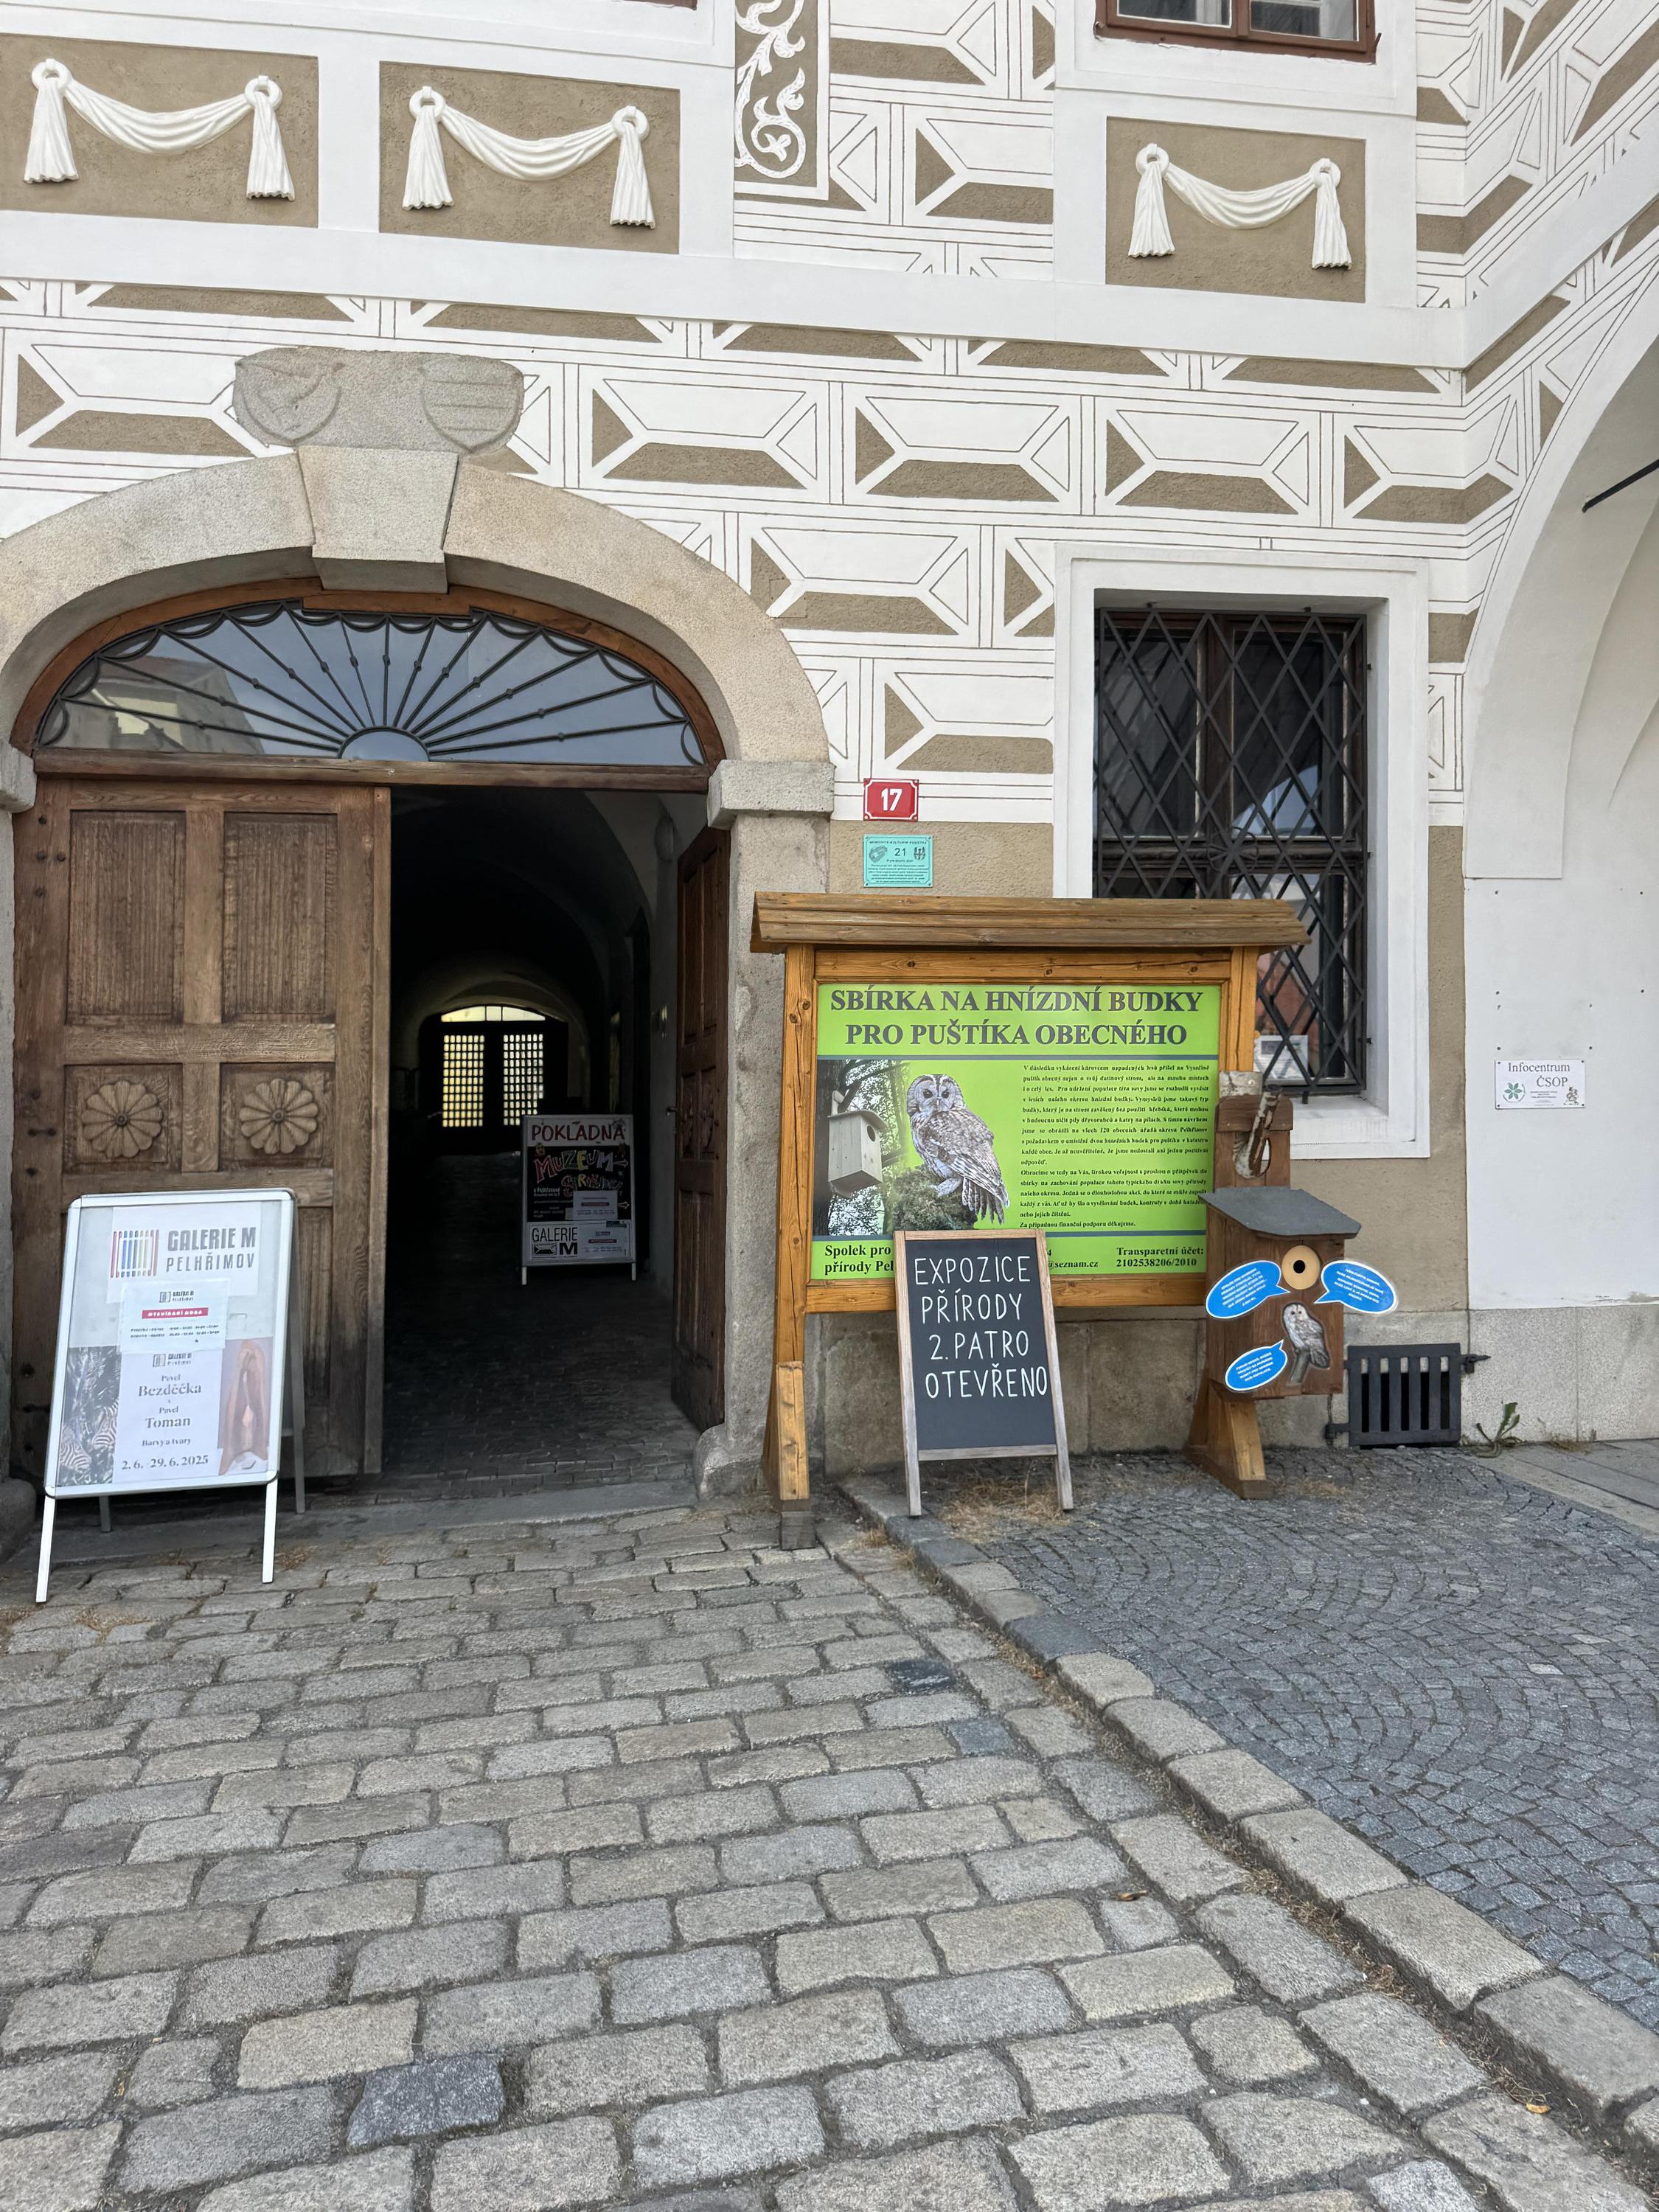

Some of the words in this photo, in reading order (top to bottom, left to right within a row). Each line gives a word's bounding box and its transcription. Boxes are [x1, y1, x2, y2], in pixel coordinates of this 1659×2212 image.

[881, 788, 902, 811] 17
[894, 848, 906, 856] 21
[831, 985, 933, 1011] SBÍRKA
[941, 990, 979, 1011] NA
[985, 986, 1102, 1012] HNÍZDNÍ
[1108, 990, 1203, 1012] BUDKY
[846, 1023, 903, 1045] PRO
[911, 1018, 1029, 1046] PUŠTÍKA
[1036, 1020, 1188, 1046] OBECNÉHO
[1509, 1062, 1570, 1072] Infocentrum
[1537, 1076, 1568, 1087] ČSOP
[532, 1124, 625, 1141] POKLADNA
[534, 1150, 613, 1183] MUZEUM
[167, 1228, 237, 1251] GALERIE
[241, 1227, 257, 1248] M
[532, 1227, 578, 1242] GALERIE
[559, 1242, 578, 1255] M
[825, 1245, 866, 1259] Spolek
[870, 1246, 891, 1258] pro
[1116, 1246, 1178, 1257] Transparetní
[1181, 1246, 1204, 1256] účet:
[166, 1252, 255, 1273] PELHŘIMOV
[824, 1261, 872, 1276] přírody
[875, 1260, 894, 1271] Pel
[1048, 1260, 1099, 1270] @seznam.cz
[1116, 1259, 1197, 1267] 2102538206/2010
[914, 1256, 1031, 1285] EXPOZICE
[922, 1288, 1022, 1324] PŘÍRODY
[929, 1334, 949, 1360] 2.
[955, 1330, 1029, 1360] PATRO
[161, 1374, 181, 1382] Pavel
[925, 1363, 1048, 1399] OTEVŘENO
[139, 1382, 202, 1397] Bezděčka
[145, 1417, 191, 1428] Toman
[122, 1461, 132, 1470] 2.
[133, 1459, 144, 1470] 6.
[150, 1458, 167, 1468] 29.
[169, 1457, 180, 1467] 6.
[181, 1455, 209, 1465] 2025
